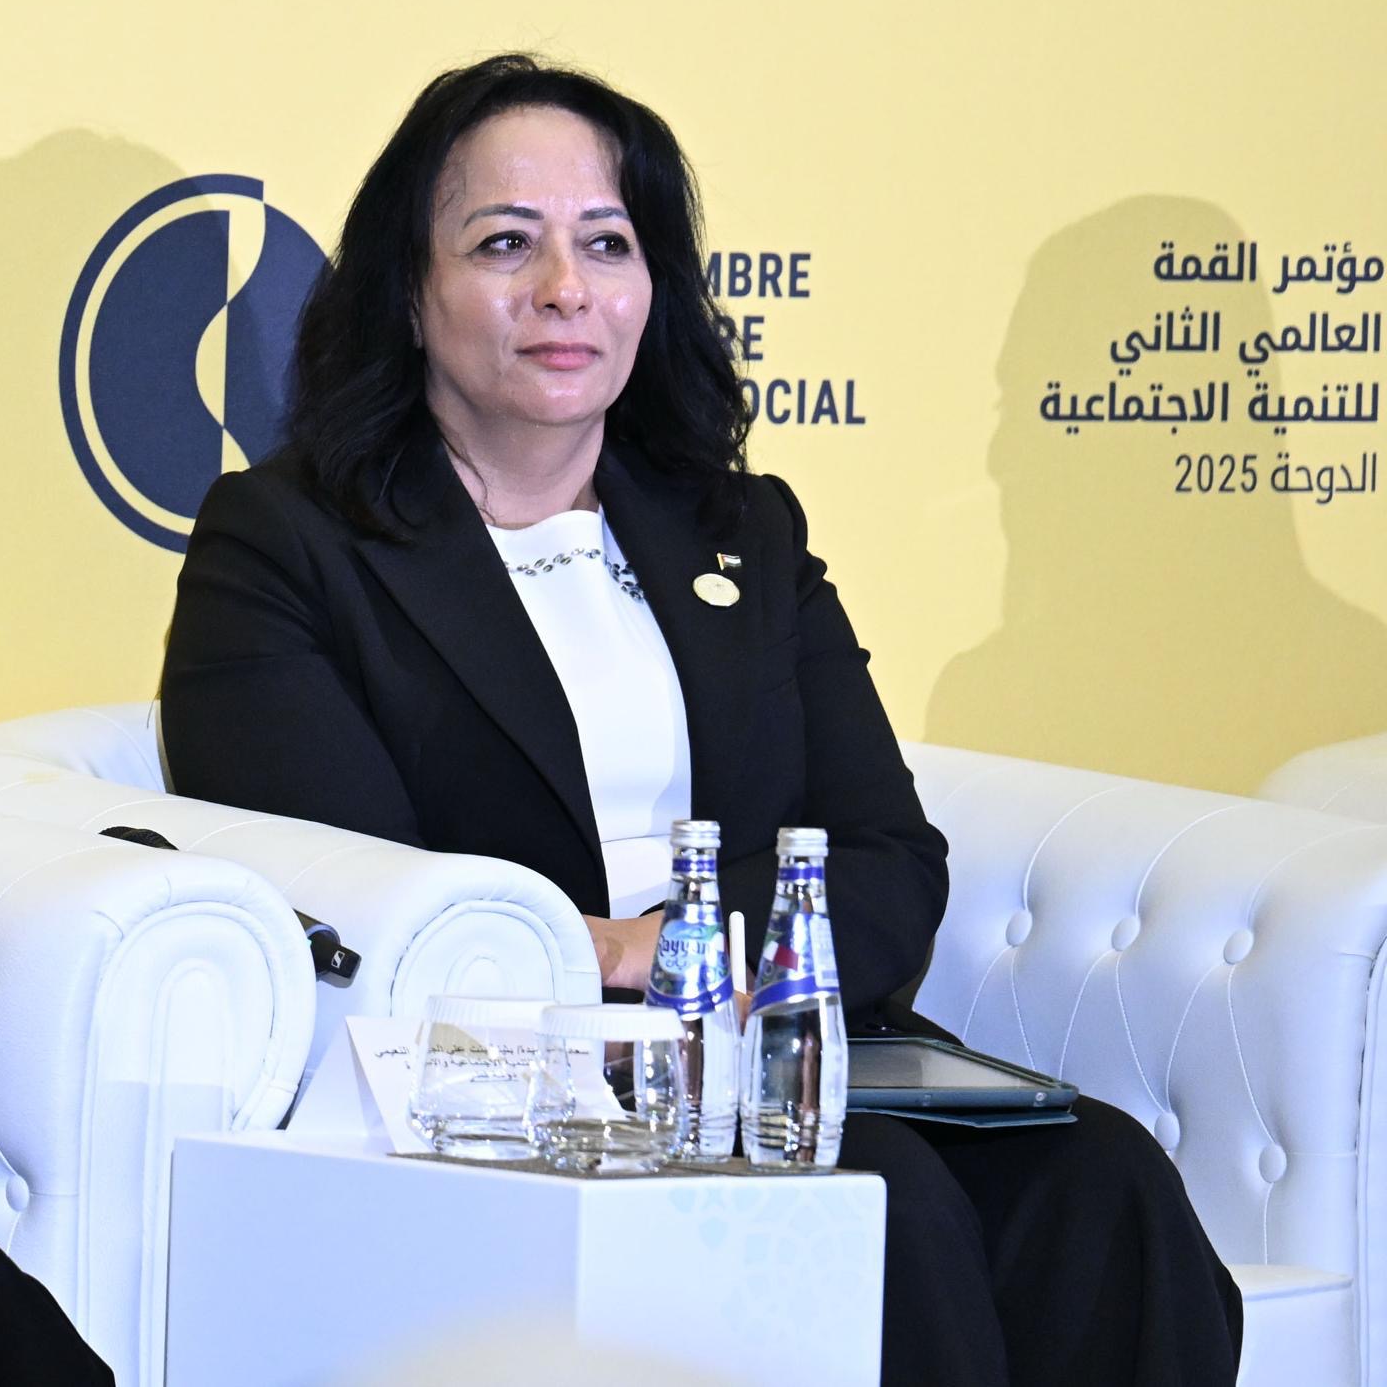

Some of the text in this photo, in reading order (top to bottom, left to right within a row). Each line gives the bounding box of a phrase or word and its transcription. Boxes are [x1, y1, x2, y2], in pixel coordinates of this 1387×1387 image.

[1153, 241, 1385, 295] مؤتمر القمة
[1109, 306, 1382, 377] العالمي الثاني
[1039, 381, 1380, 436] للتنمية الاجتماعية
[1175, 451, 1377, 505] الدوحة 2025
